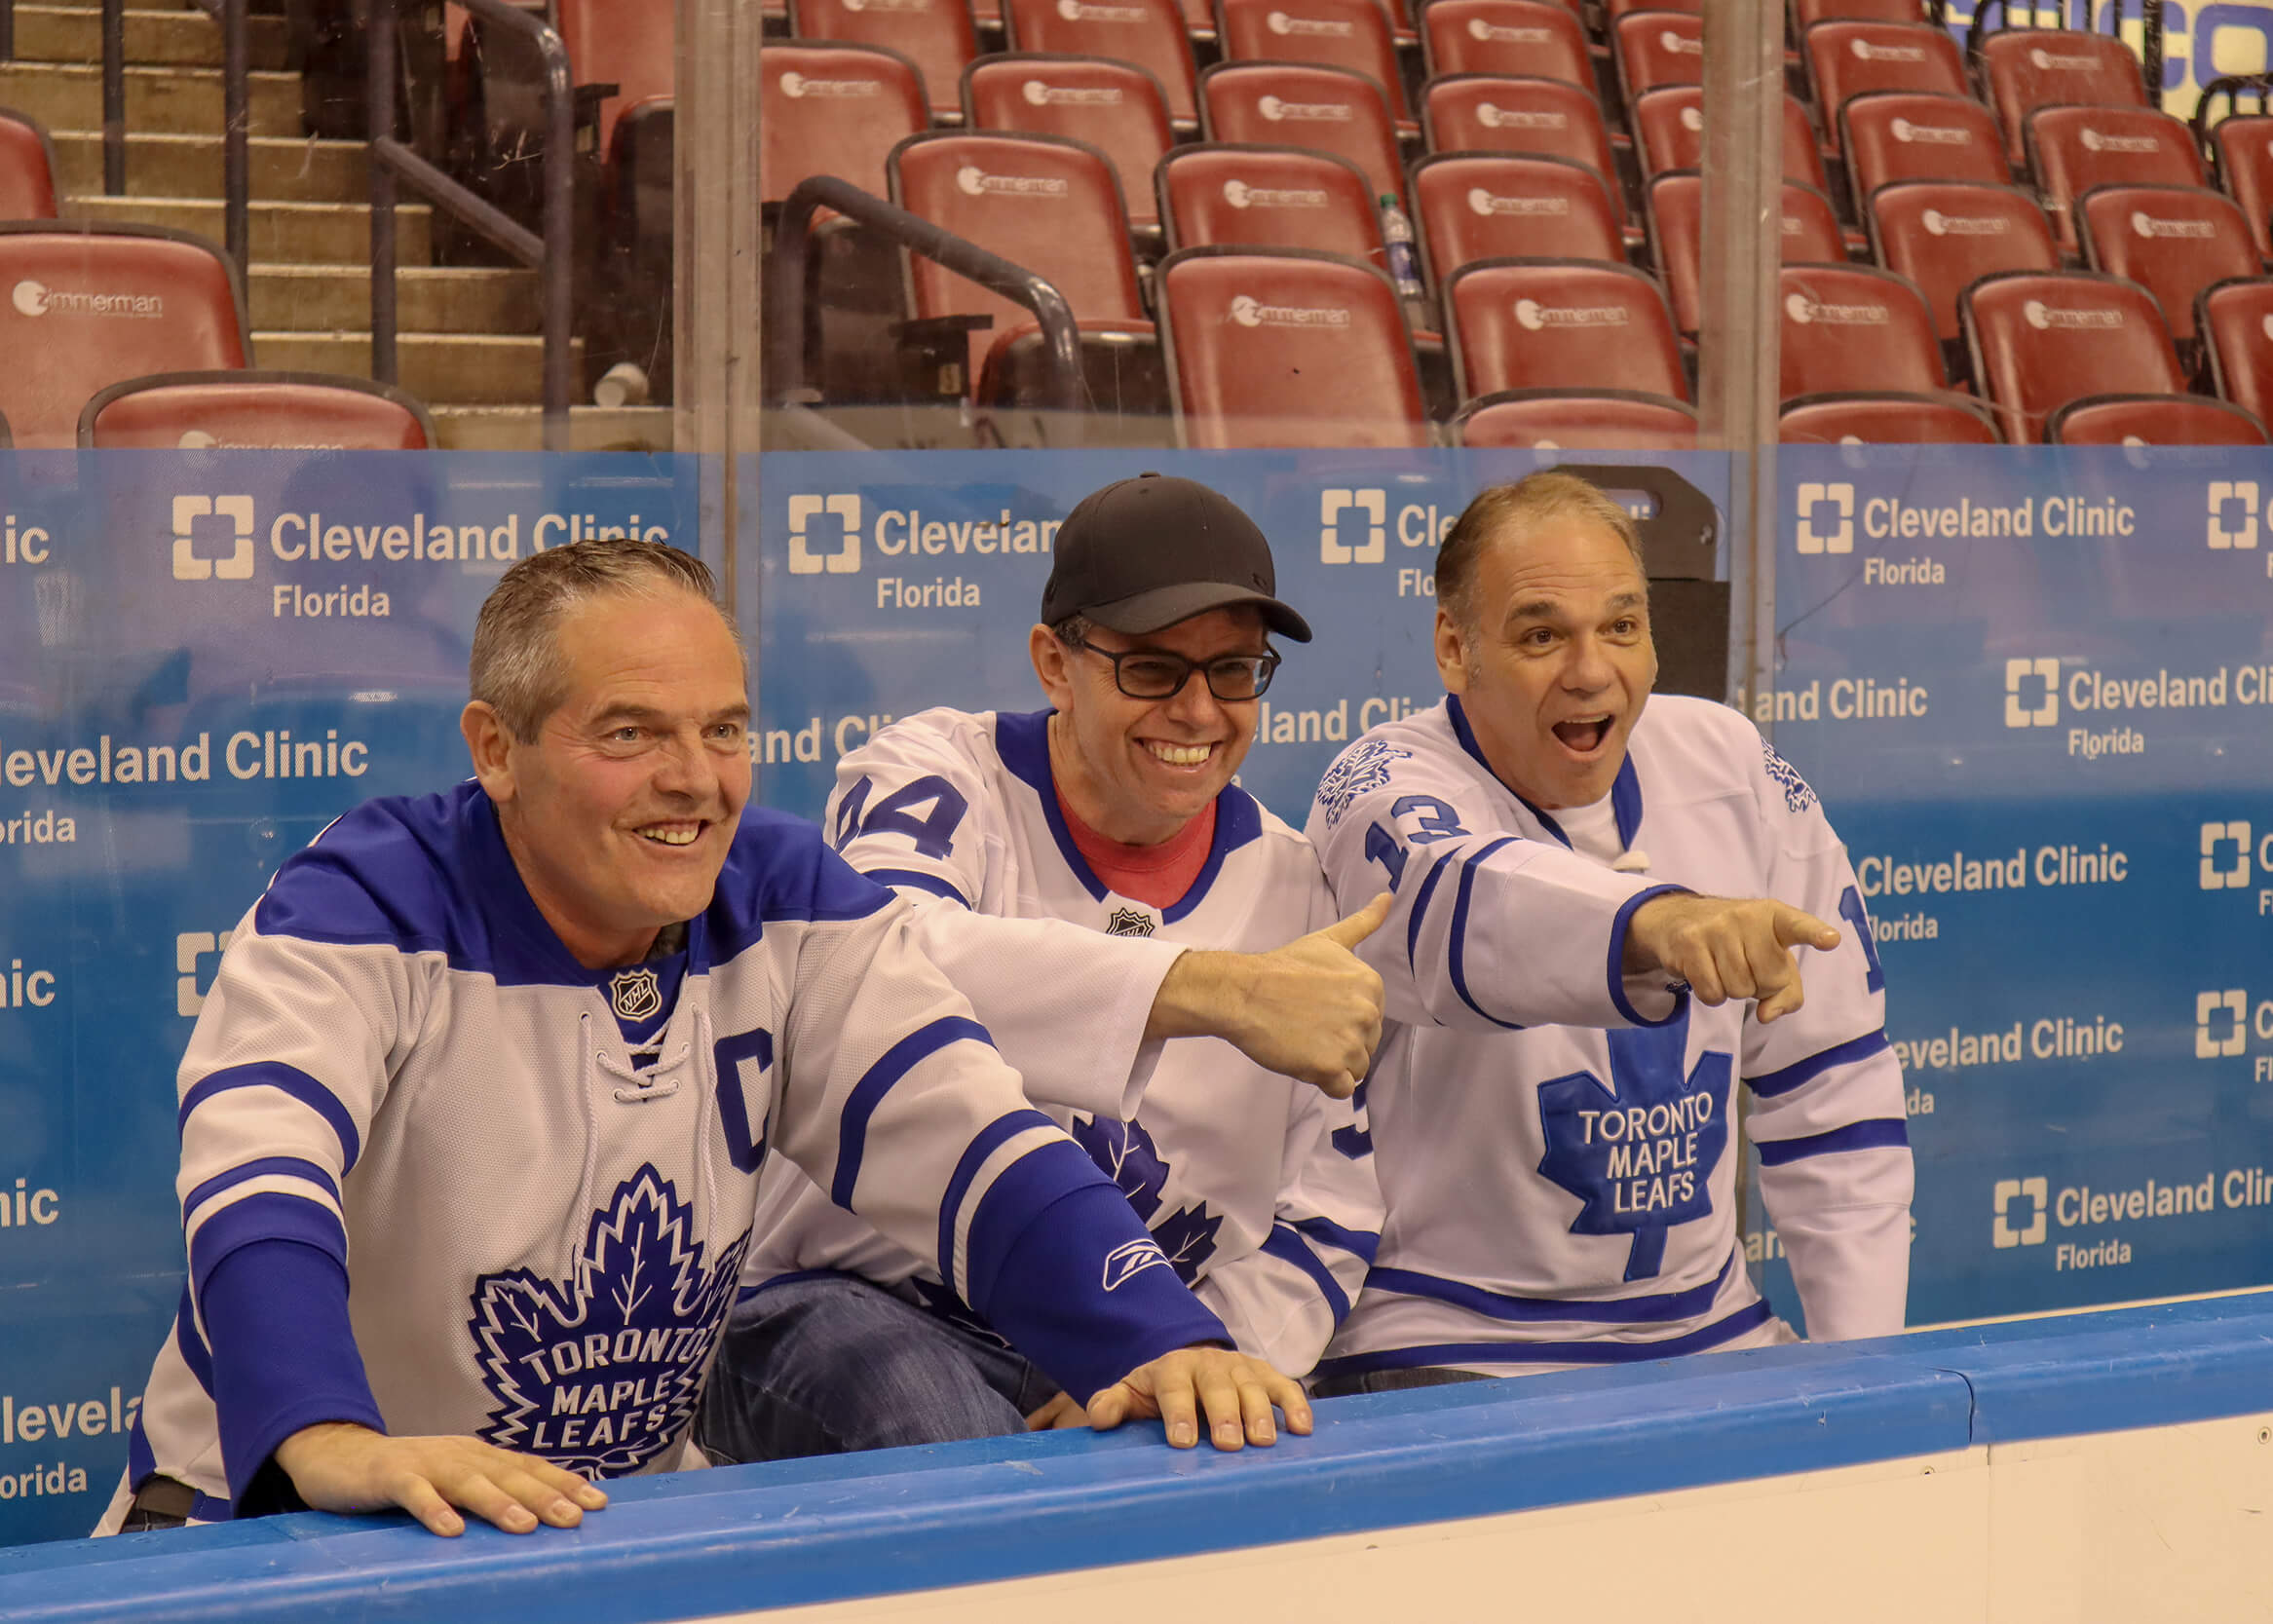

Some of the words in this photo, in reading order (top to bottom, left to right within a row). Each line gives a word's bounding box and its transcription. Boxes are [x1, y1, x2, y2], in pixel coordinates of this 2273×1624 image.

[37, 287, 162, 314] zimmerman
[270, 514, 519, 561] Cleveland
[876, 510, 1063, 554] Clevelan
[1398, 504, 1458, 548] Cle
[1864, 498, 2032, 539] Cleveland
[2042, 497, 2134, 536] Clinic
[878, 577, 980, 608] Florida
[1399, 568, 1435, 597] Flo
[1865, 557, 1945, 585] Florida
[273, 585, 390, 617] Florida
[1830, 678, 1927, 719] Clinic
[2068, 666, 2226, 710] Cleveland
[2237, 665, 2273, 704] Cli
[1260, 698, 1348, 744] land
[2069, 728, 2143, 755] Florida
[0, 733, 208, 787] eveland
[226, 730, 368, 779] Clinic
[1365, 795, 1473, 894] 13
[1858, 850, 2025, 896] Cleveland
[2036, 845, 2128, 885] Clinic
[624, 983, 648, 1011] NHL
[1893, 1021, 2022, 1071] eveland
[2032, 1016, 2123, 1059] Clinic
[714, 1028, 773, 1174] C
[1578, 1092, 1713, 1145] TORONTO
[1607, 1132, 1699, 1179] MAPLE
[1613, 1171, 1694, 1214] LEAFS
[2058, 1174, 2214, 1227] Cleveland
[2058, 1240, 2131, 1271] Florida
[519, 1328, 708, 1384] TORONTO
[1, 1387, 142, 1443] levela
[551, 1370, 675, 1416] MAPLE
[532, 1404, 667, 1448] LEAFS
[0, 1463, 87, 1498] orida
